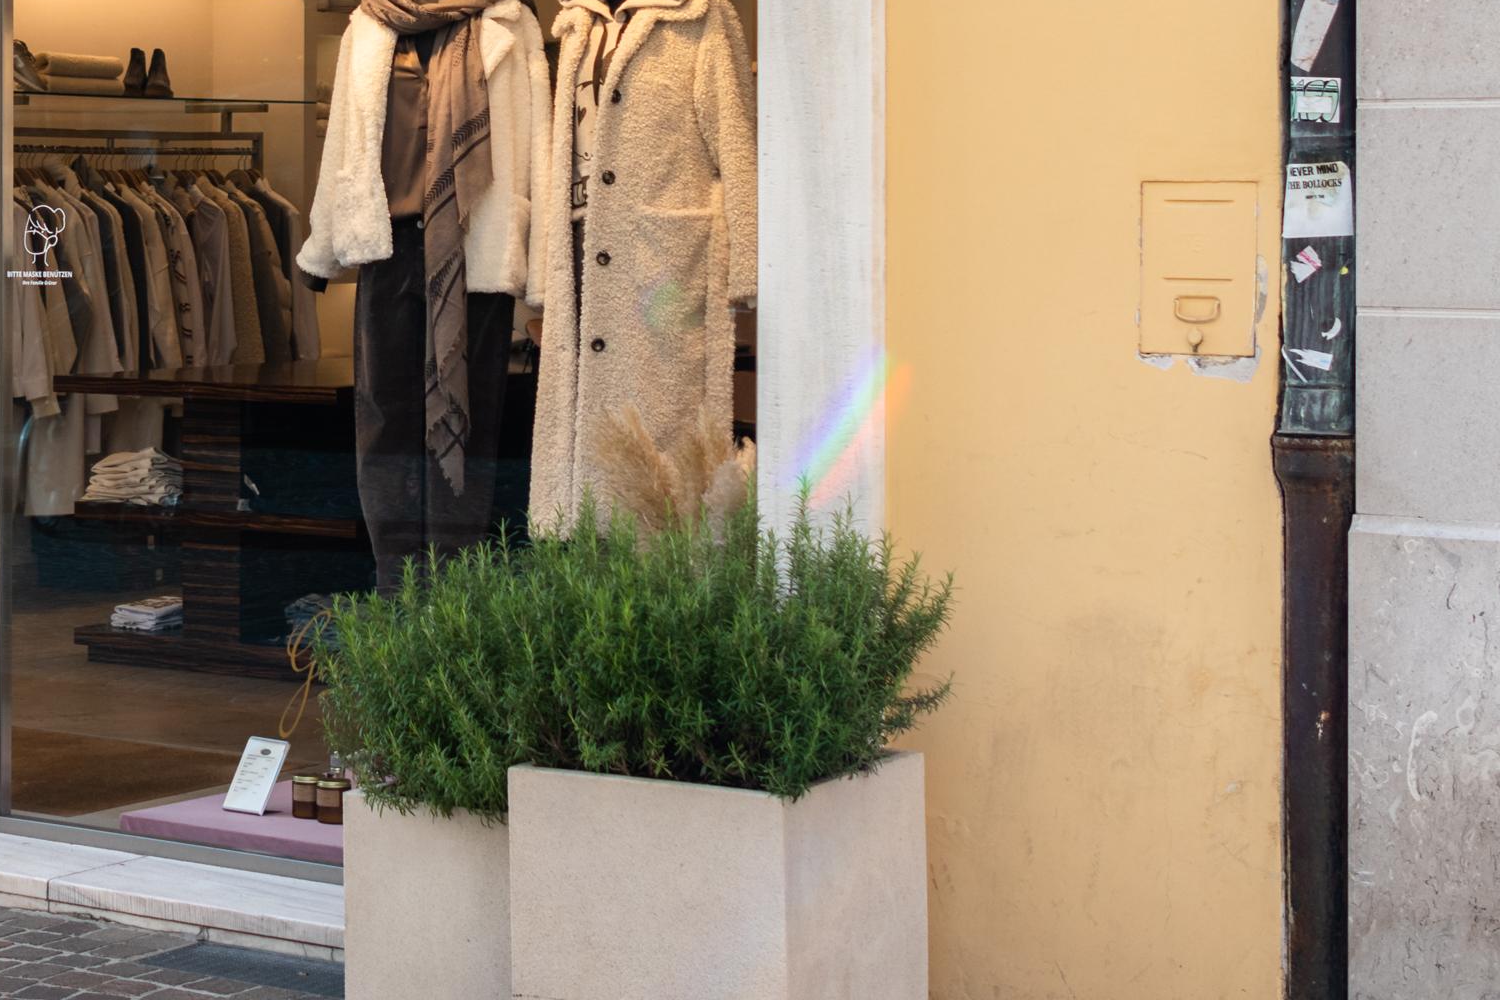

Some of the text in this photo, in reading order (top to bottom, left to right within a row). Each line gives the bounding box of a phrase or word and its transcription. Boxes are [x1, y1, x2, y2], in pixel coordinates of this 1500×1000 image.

[1316, 162, 1339, 175] MIND
[1302, 178, 1343, 190] BOLLOCKS
[6, 269, 73, 278] BITTE MASKE BENÜTZEN
